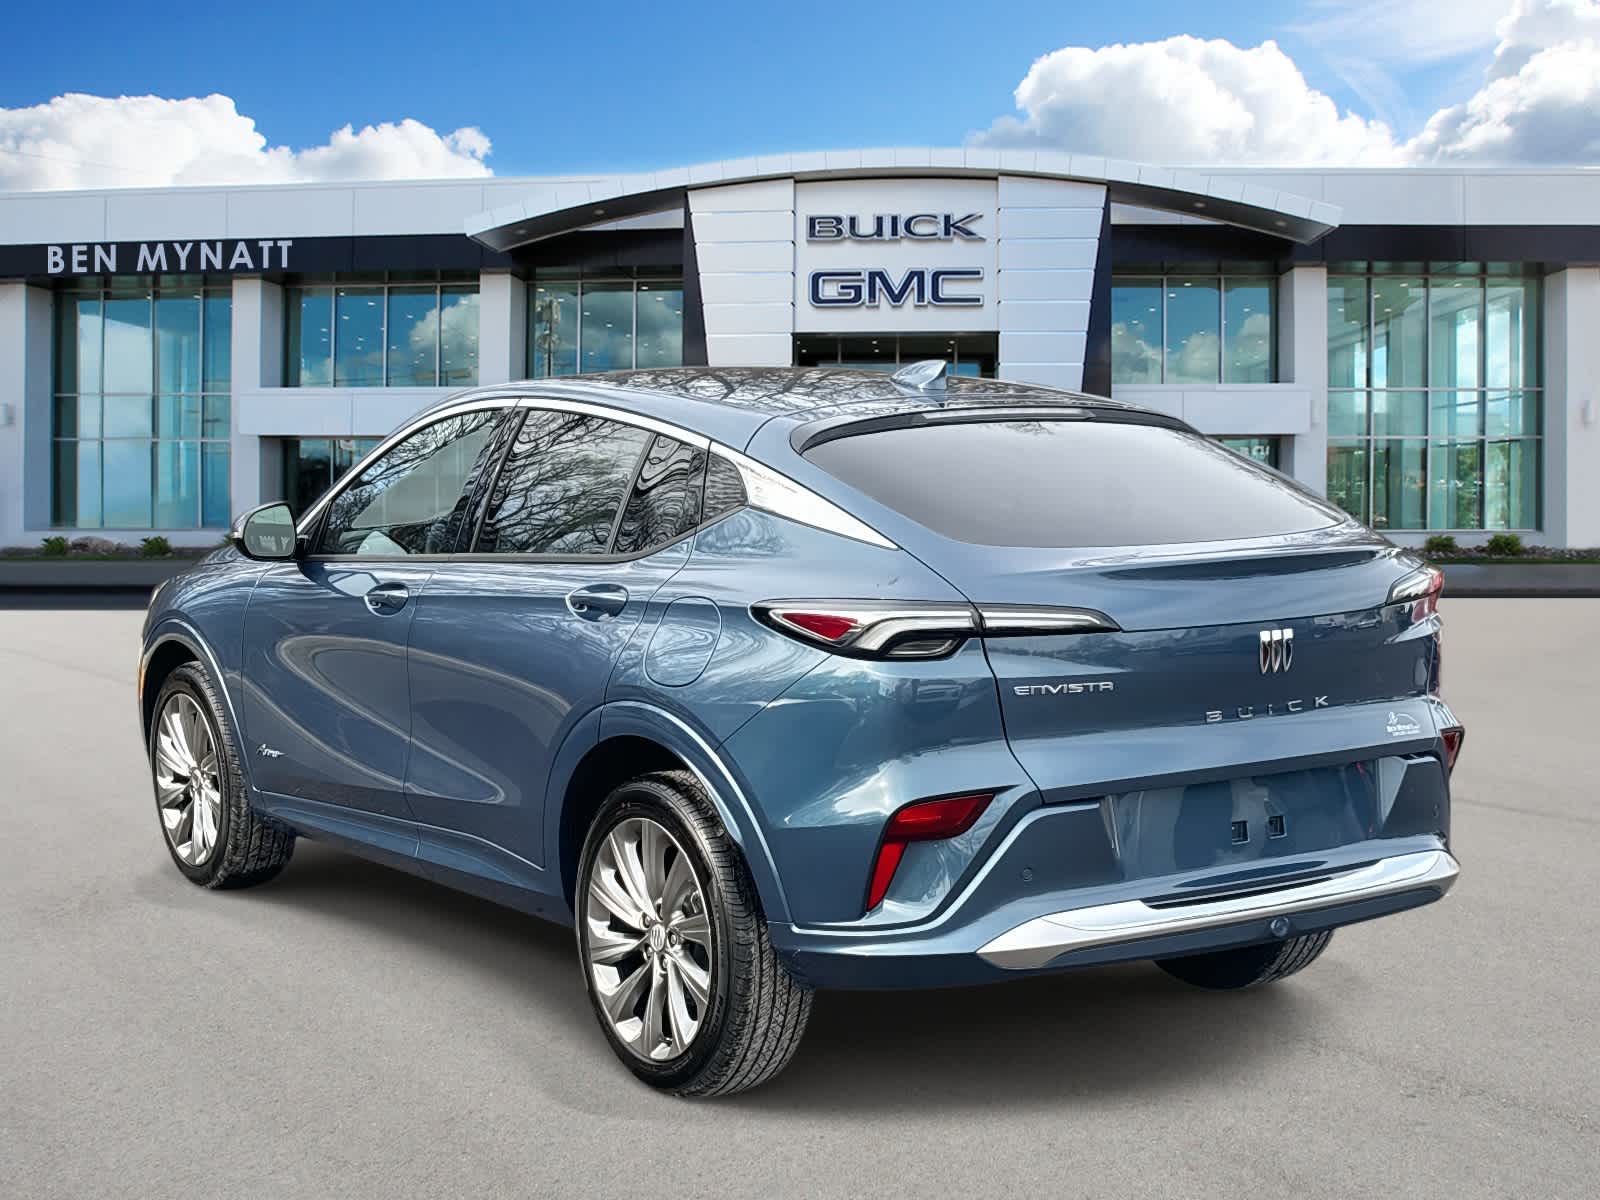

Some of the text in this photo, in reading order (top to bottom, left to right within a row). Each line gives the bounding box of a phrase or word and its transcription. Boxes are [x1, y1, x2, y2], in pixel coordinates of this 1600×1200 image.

[807, 213, 986, 242] BUICK
[47, 240, 293, 274] BEN MYNATT
[808, 267, 984, 308] GMC
[1013, 681, 1114, 696] ENVISTA
[1205, 695, 1329, 723] BUICK
